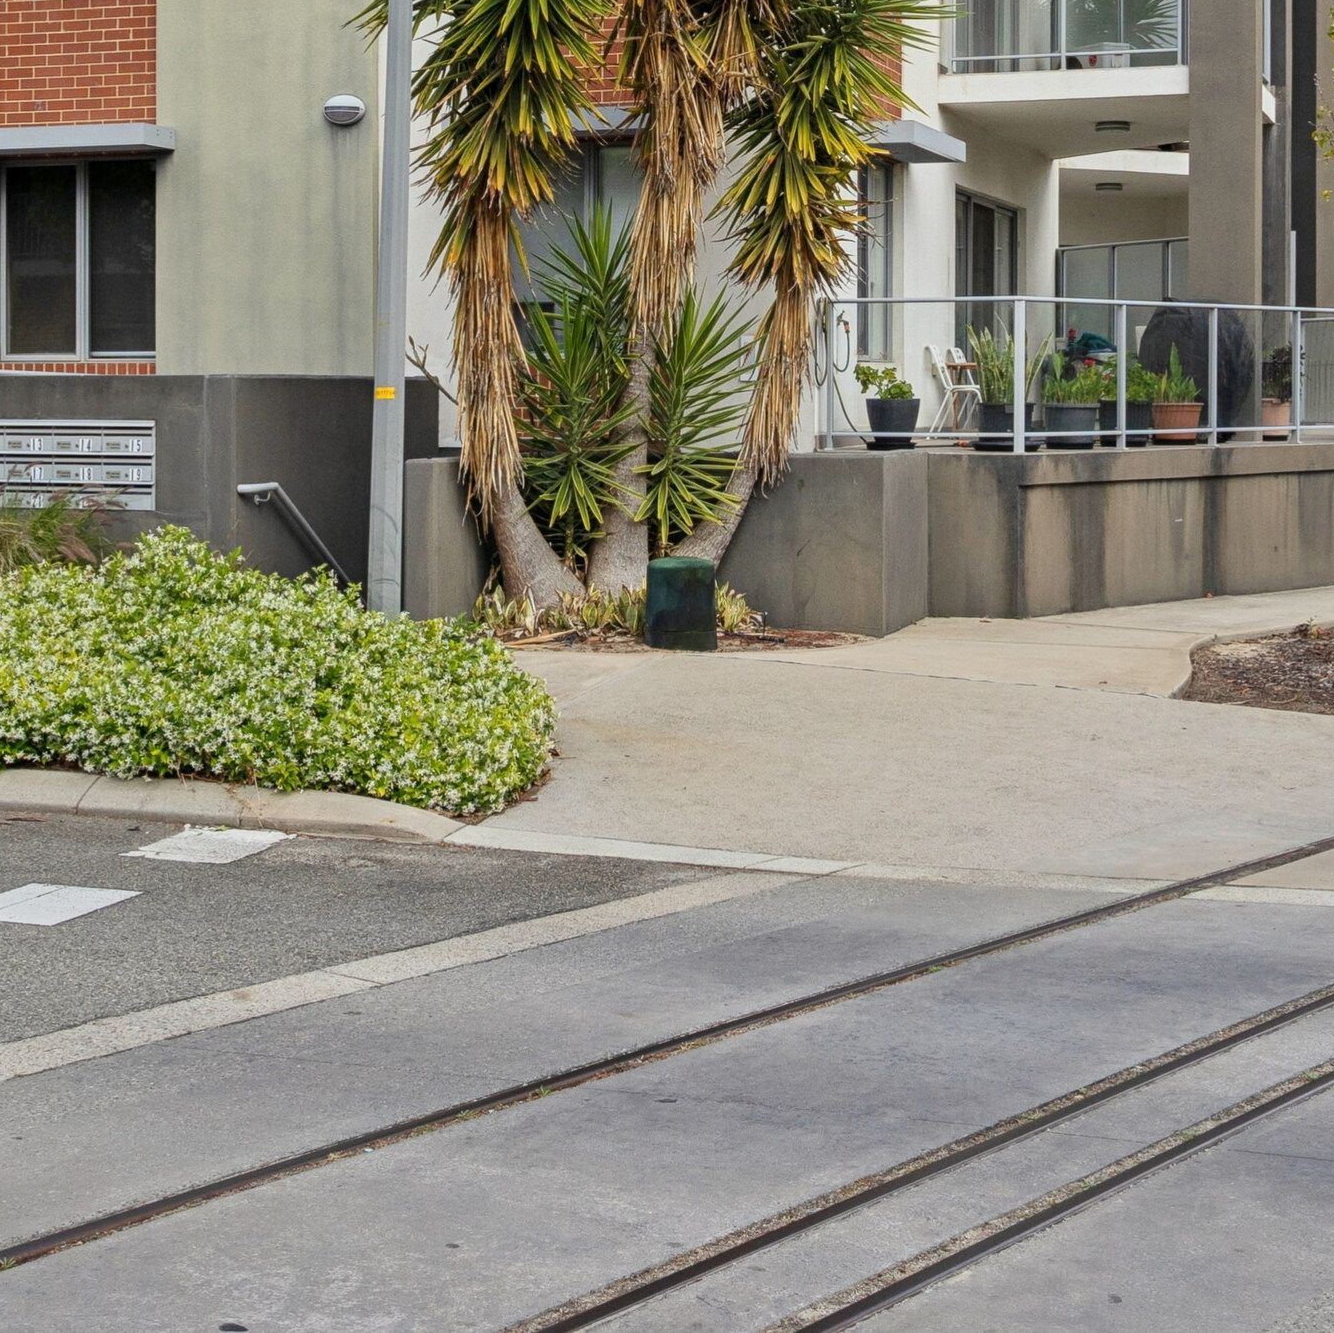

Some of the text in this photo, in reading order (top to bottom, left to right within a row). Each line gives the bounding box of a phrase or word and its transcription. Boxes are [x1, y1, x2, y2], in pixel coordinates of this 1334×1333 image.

[31, 438, 43, 451] 13
[80, 438, 92, 451] 14
[130, 439, 142, 452] 15
[32, 467, 44, 479] 17
[131, 468, 142, 481] 19
